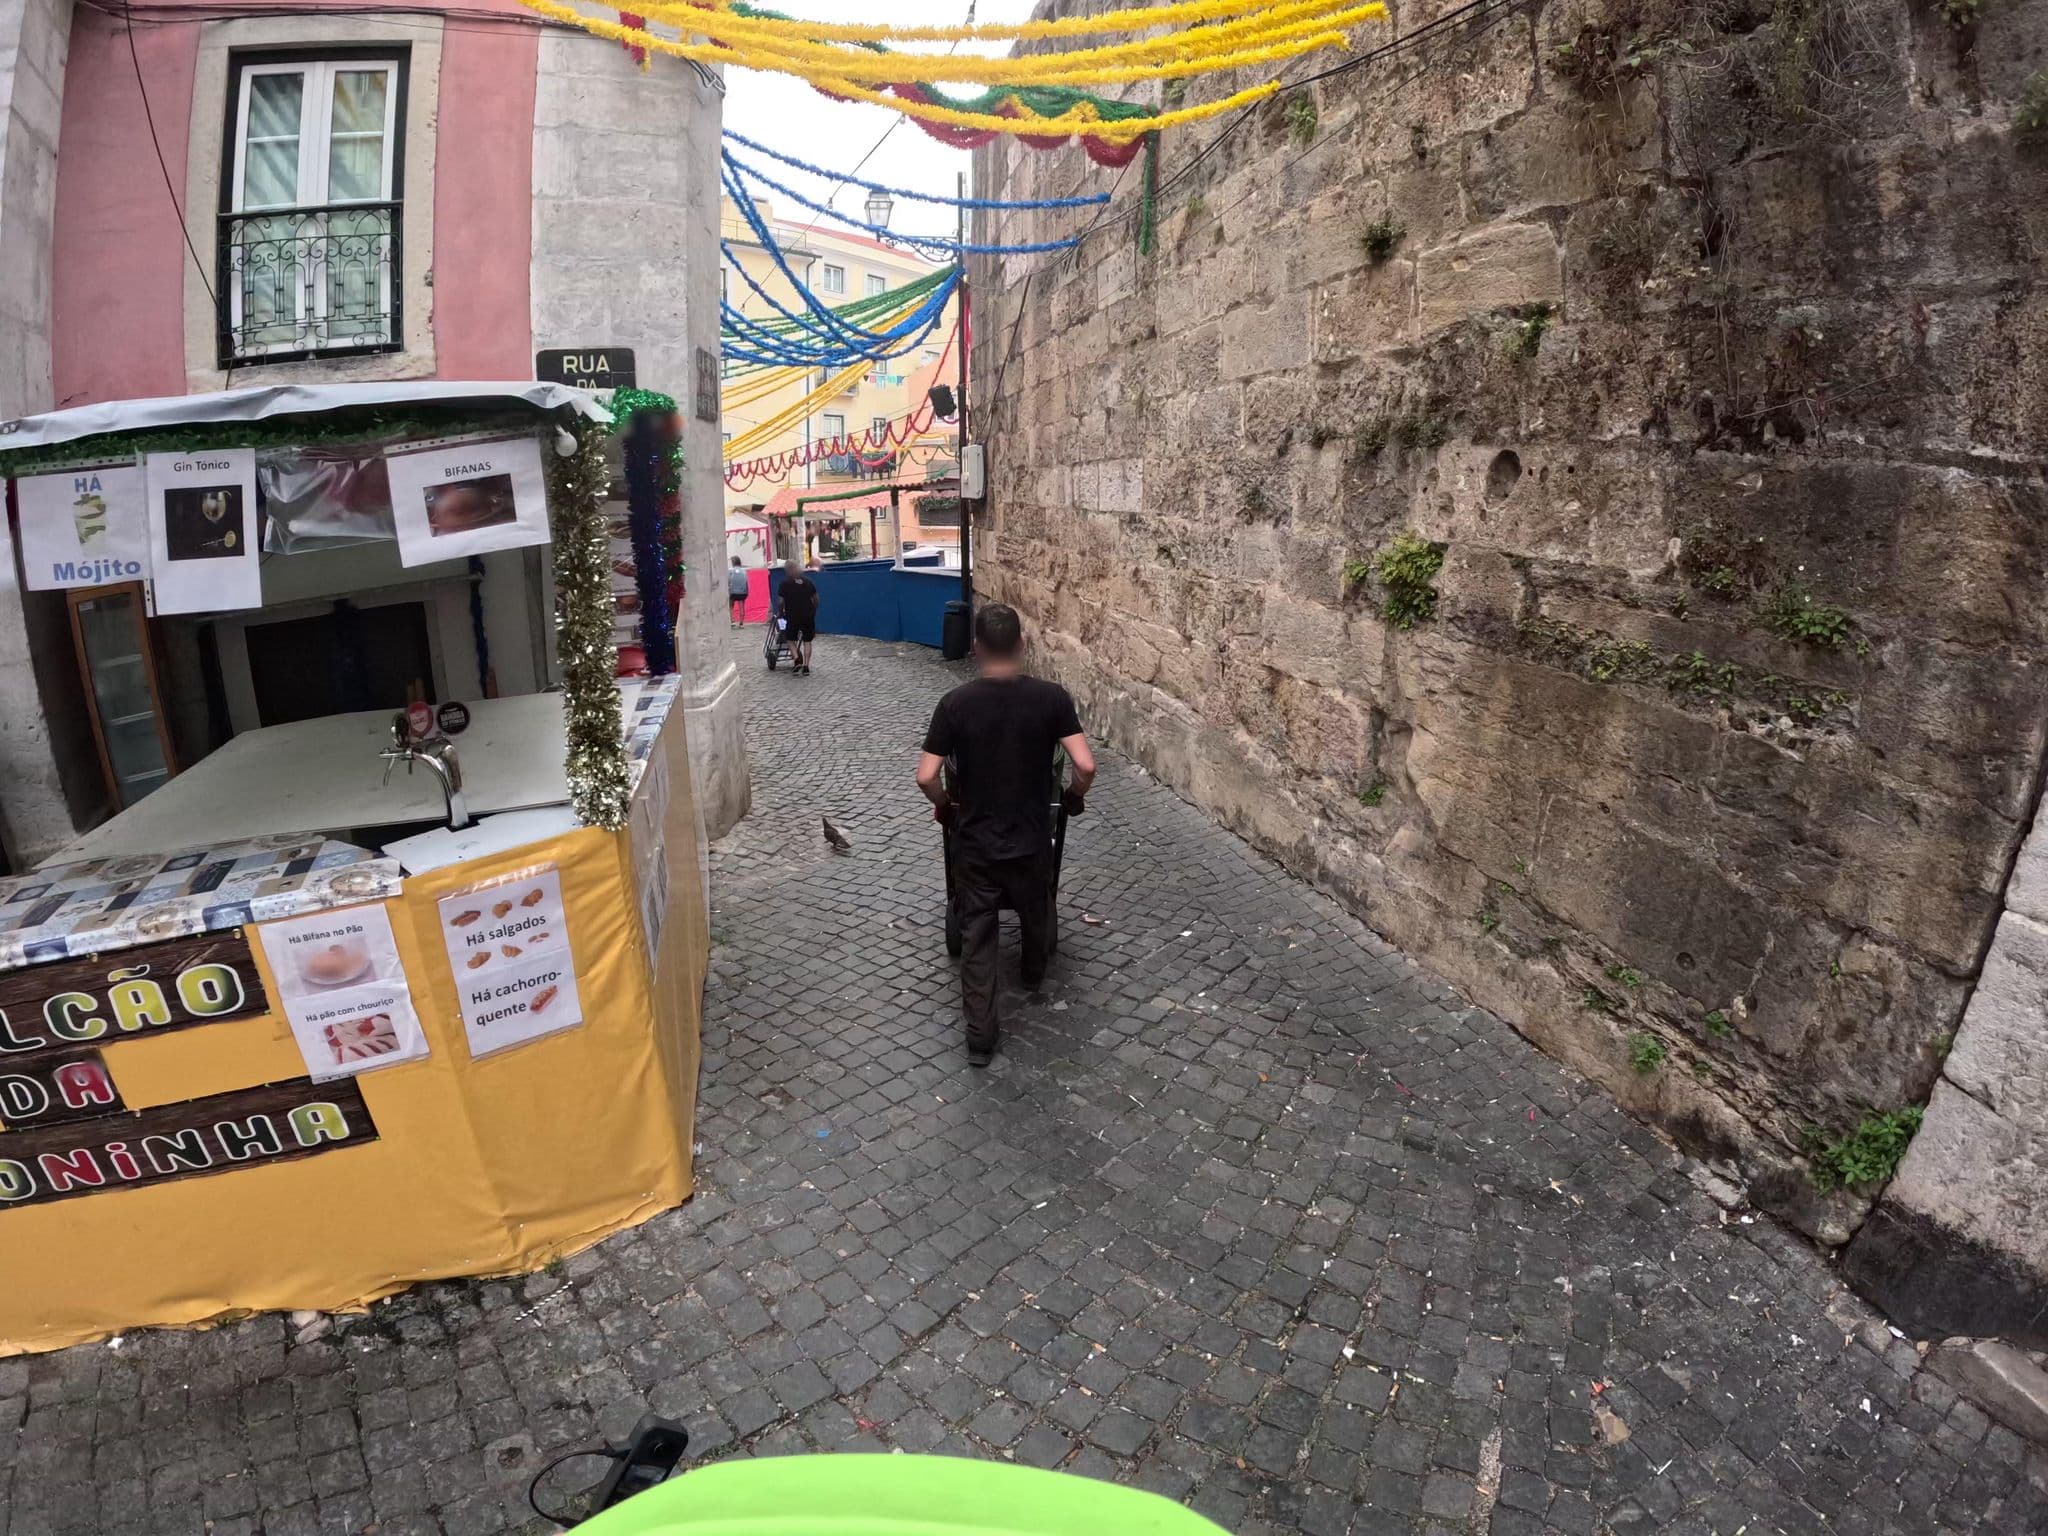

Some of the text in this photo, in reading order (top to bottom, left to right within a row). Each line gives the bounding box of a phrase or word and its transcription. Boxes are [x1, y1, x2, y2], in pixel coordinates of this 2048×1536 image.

[563, 354, 610, 374] RUA
[173, 460, 230, 472] Gin Tónico
[445, 461, 492, 477] BIFANAS
[74, 473, 103, 493] HÁ
[53, 559, 141, 583] Mójito
[288, 924, 363, 945] Há Bifana no Pão
[466, 915, 546, 947] Há salgados
[472, 970, 562, 1004] Há cachorro-
[305, 997, 394, 1022] Há pão com chouriço
[476, 1002, 527, 1026] quente
[0, 1062, 115, 1119] DA
